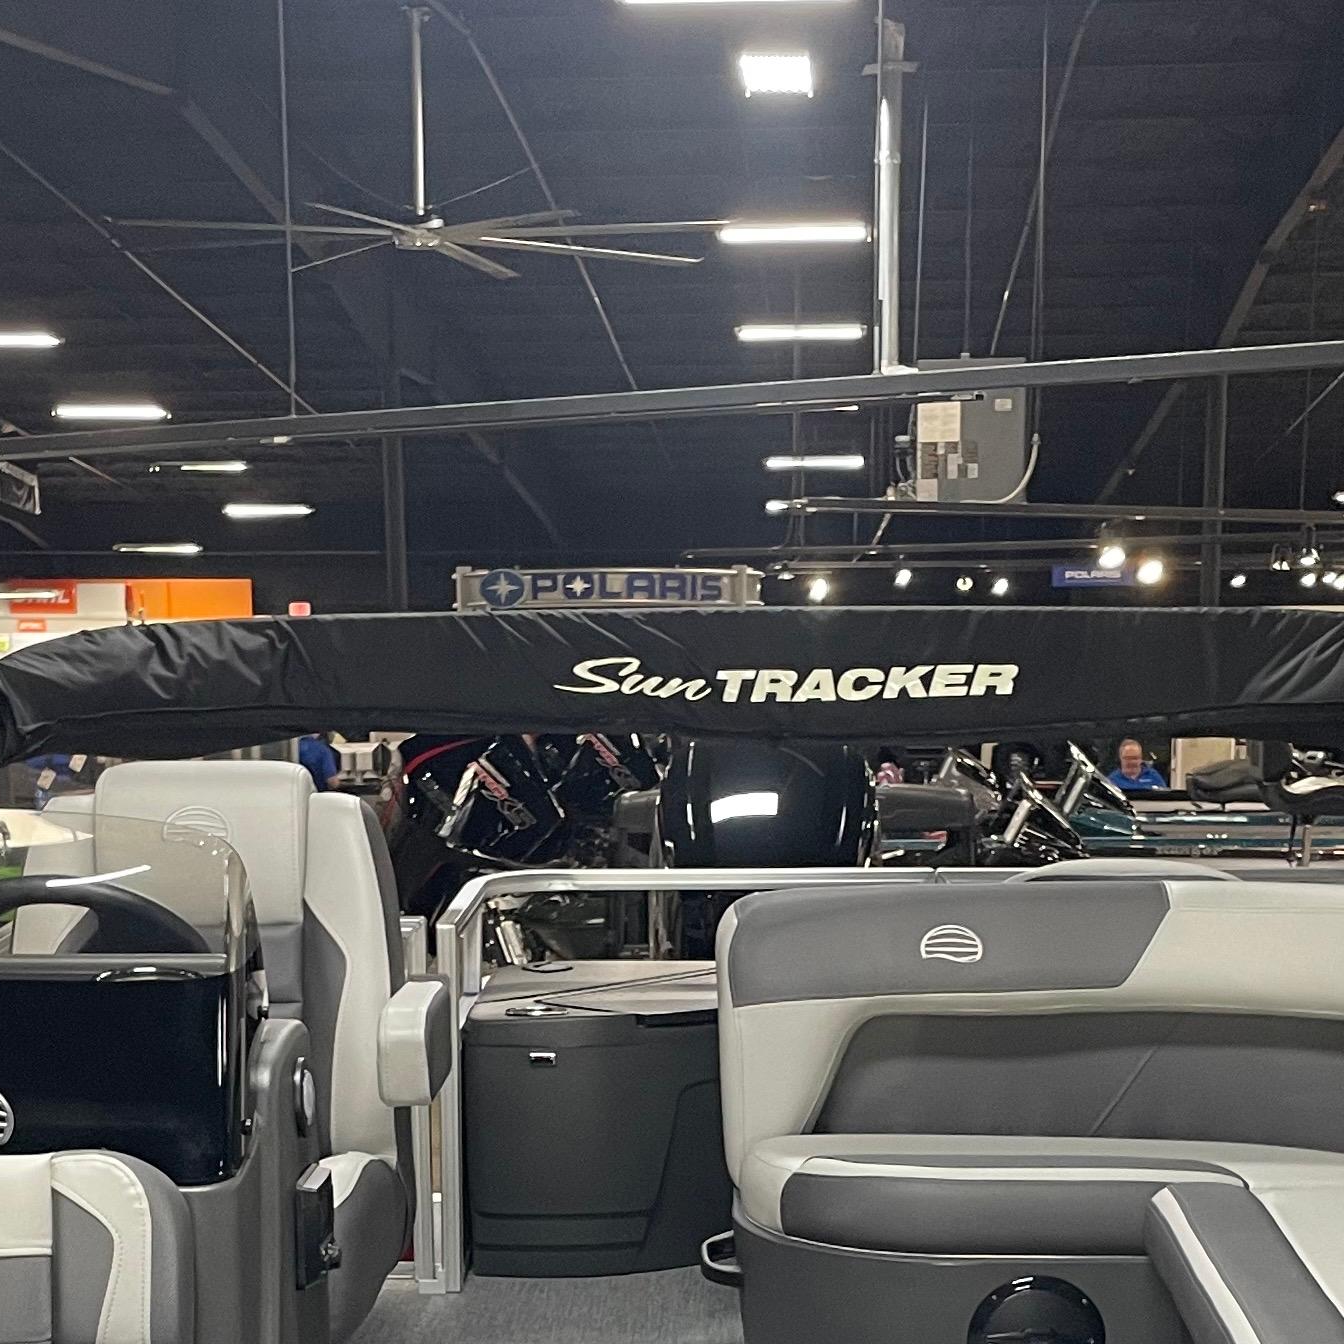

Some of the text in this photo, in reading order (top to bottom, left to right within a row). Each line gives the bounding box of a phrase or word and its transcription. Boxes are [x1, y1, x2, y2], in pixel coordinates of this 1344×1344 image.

[531, 572, 723, 601] POLARIS
[552, 656, 1020, 703] Sun TRACKER
